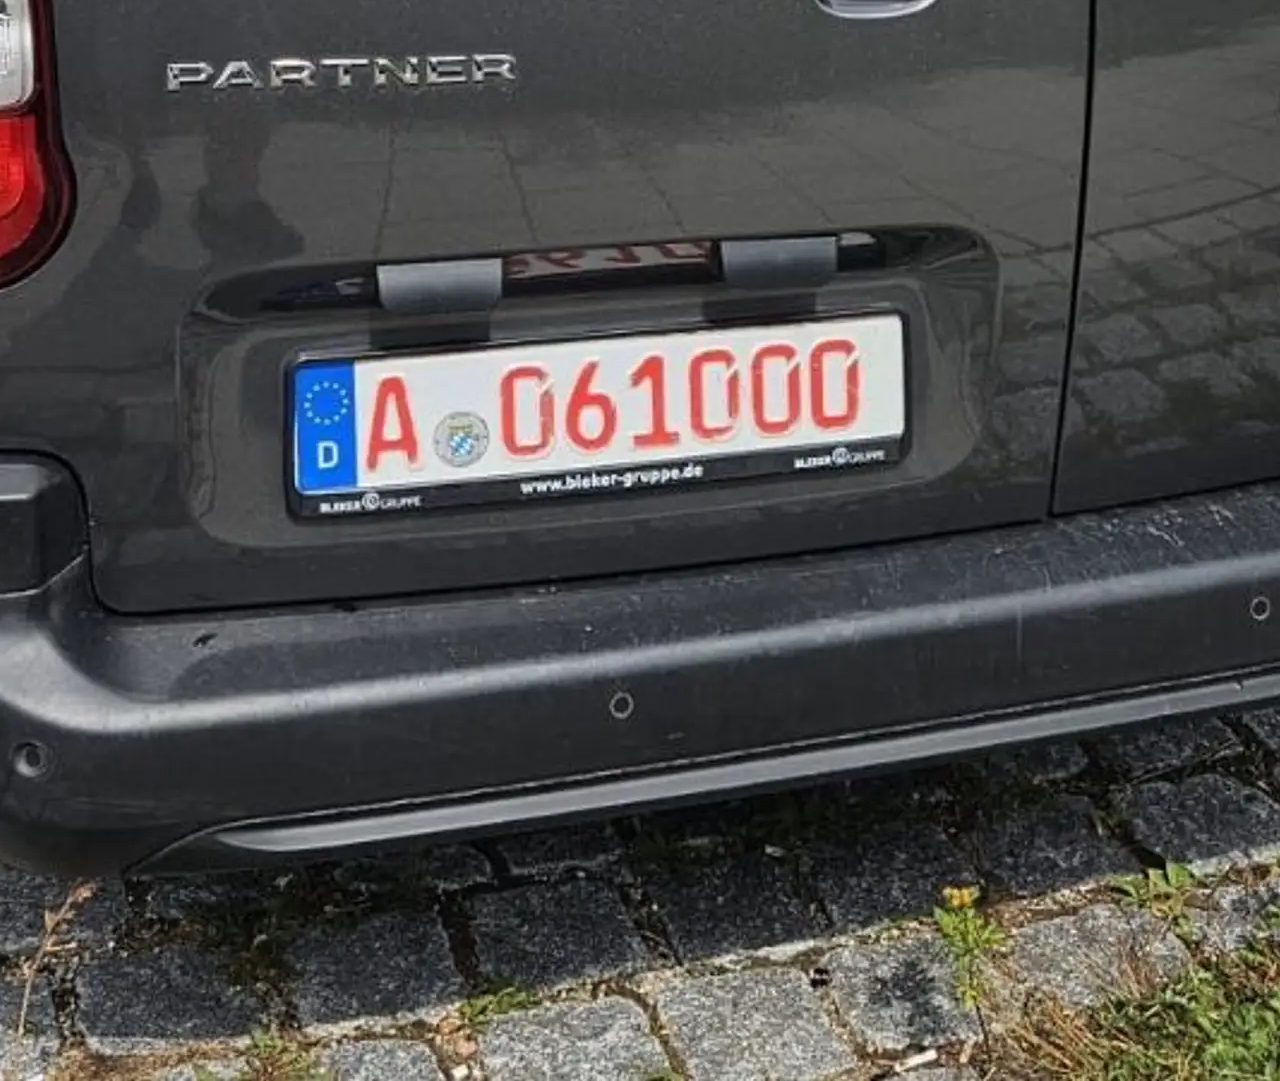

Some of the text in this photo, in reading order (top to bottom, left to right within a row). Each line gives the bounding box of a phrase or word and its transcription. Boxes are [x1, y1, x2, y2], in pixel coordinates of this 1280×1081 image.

[166, 54, 517, 93] PARTNER
[366, 338, 861, 473] A 061000
[317, 440, 339, 471] D
[520, 463, 704, 493] www.bleker-gruppe.de
